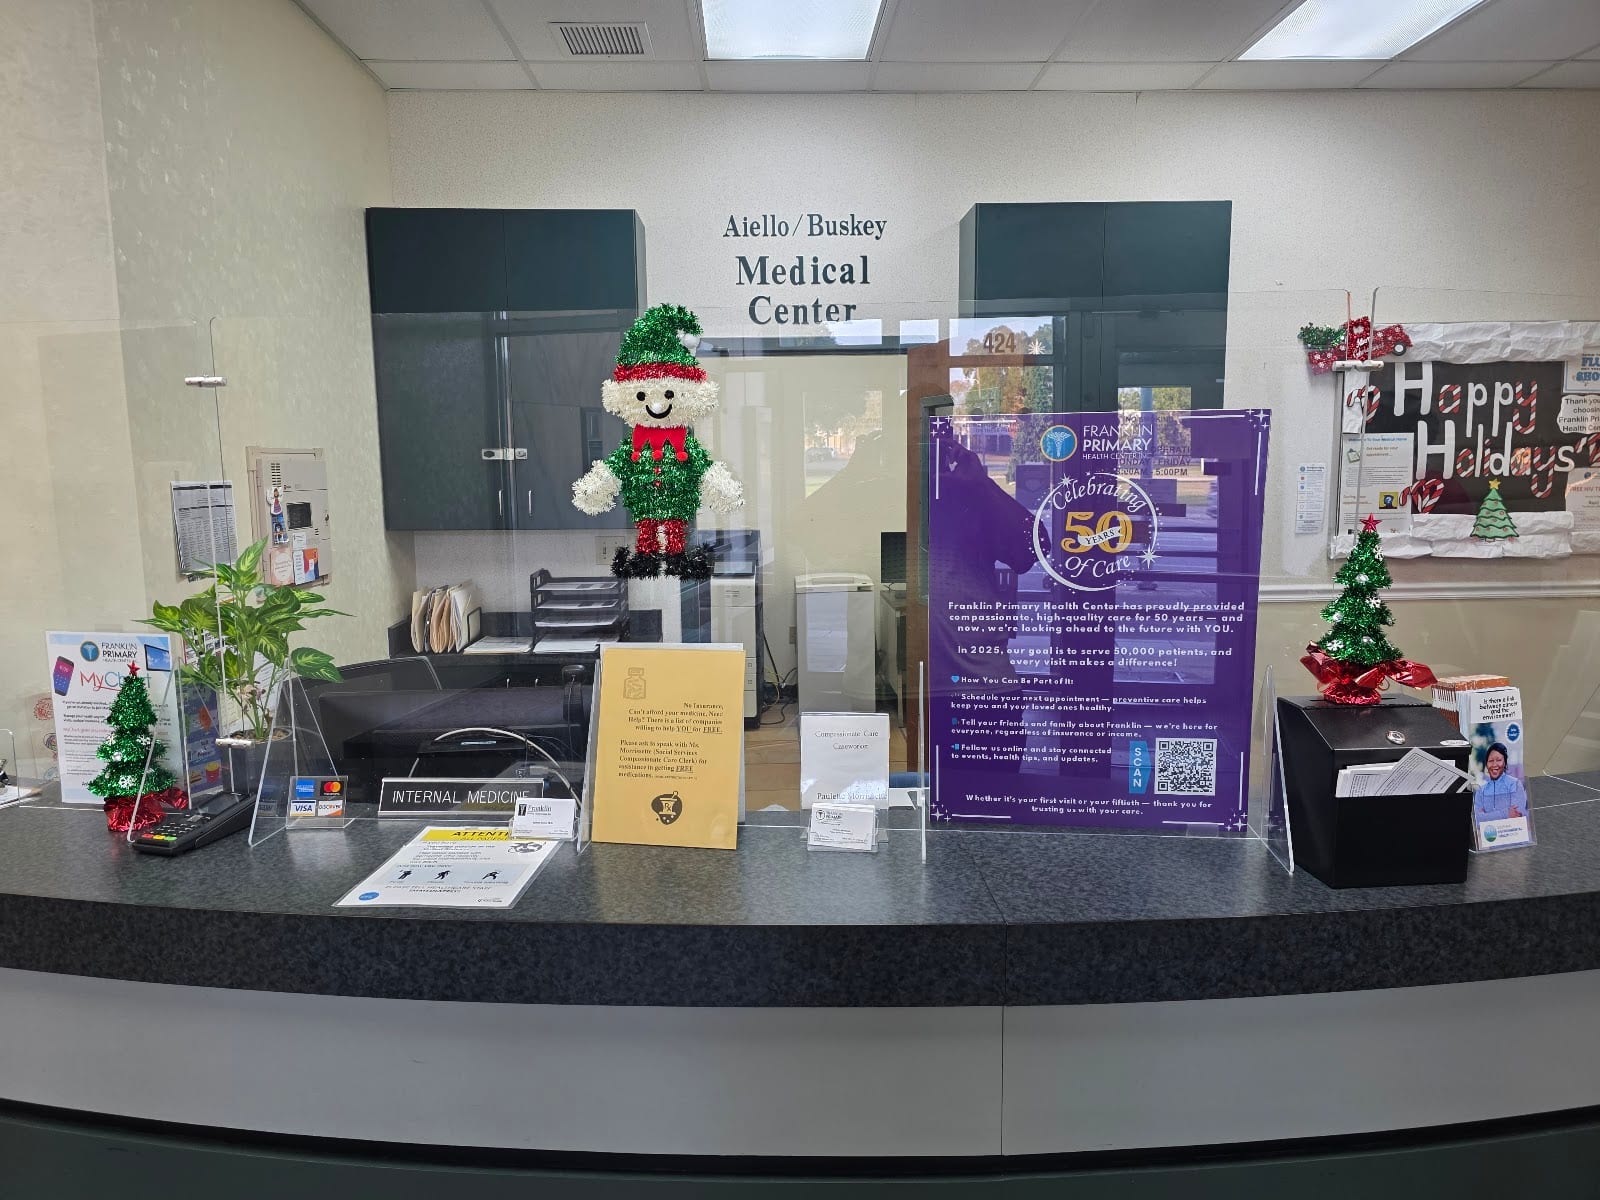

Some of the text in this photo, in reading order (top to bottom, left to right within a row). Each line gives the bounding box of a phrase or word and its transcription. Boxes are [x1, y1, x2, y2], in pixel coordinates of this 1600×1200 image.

[723, 214, 887, 240] Aiello/Buskey
[736, 256, 870, 286] Medical
[748, 296, 856, 324] Center
[984, 333, 1016, 353] 424
[1394, 361, 1538, 437] Happy
[1084, 424, 1152, 437] FRANKLIN
[1083, 438, 1152, 452] PRIMARY
[1416, 419, 1574, 498] Holidays
[1052, 476, 1147, 512] Celebrating
[1060, 511, 1132, 554] 50
[1085, 530, 1115, 544] YEARS
[1065, 556, 1130, 578] Of Care
[948, 602, 1245, 612] Franklin Primary Health Center has proudly provided
[949, 614, 1034, 622] compassionate,
[1036, 613, 1104, 622] high-quality
[1134, 614, 1151, 622] for
[1154, 614, 1168, 622] 50
[1172, 615, 1204, 623] years
[1222, 614, 1244, 622] and
[1022, 624, 1062, 634] looking
[1066, 624, 1100, 632] ahead
[1118, 624, 1136, 632] the
[1140, 624, 1172, 632] future
[1176, 624, 1200, 632] with
[1204, 624, 1234, 632] YOU.
[102, 642, 138, 650] FRANKLIN
[958, 646, 968, 654] In
[970, 646, 1004, 655] 2025,
[1028, 646, 1052, 656] goal
[1056, 646, 1064, 654] is
[1114, 647, 1154, 656] 50,000
[1158, 647, 1208, 656] patients,
[1210, 648, 1232, 656] and
[102, 650, 138, 658] PRIMARY
[1010, 659, 1040, 668] every
[1044, 658, 1066, 666] visit
[1068, 658, 1104, 666] makes
[1118, 658, 1177, 667] difference!
[1044, 695, 1100, 703] appointment
[1080, 704, 1115, 712] healthy.
[1050, 720, 1076, 729] family
[1048, 746, 1066, 754] stay
[1133, 747, 1142, 788] SCAN
[392, 790, 530, 804] INTERNAL MEDICINE
